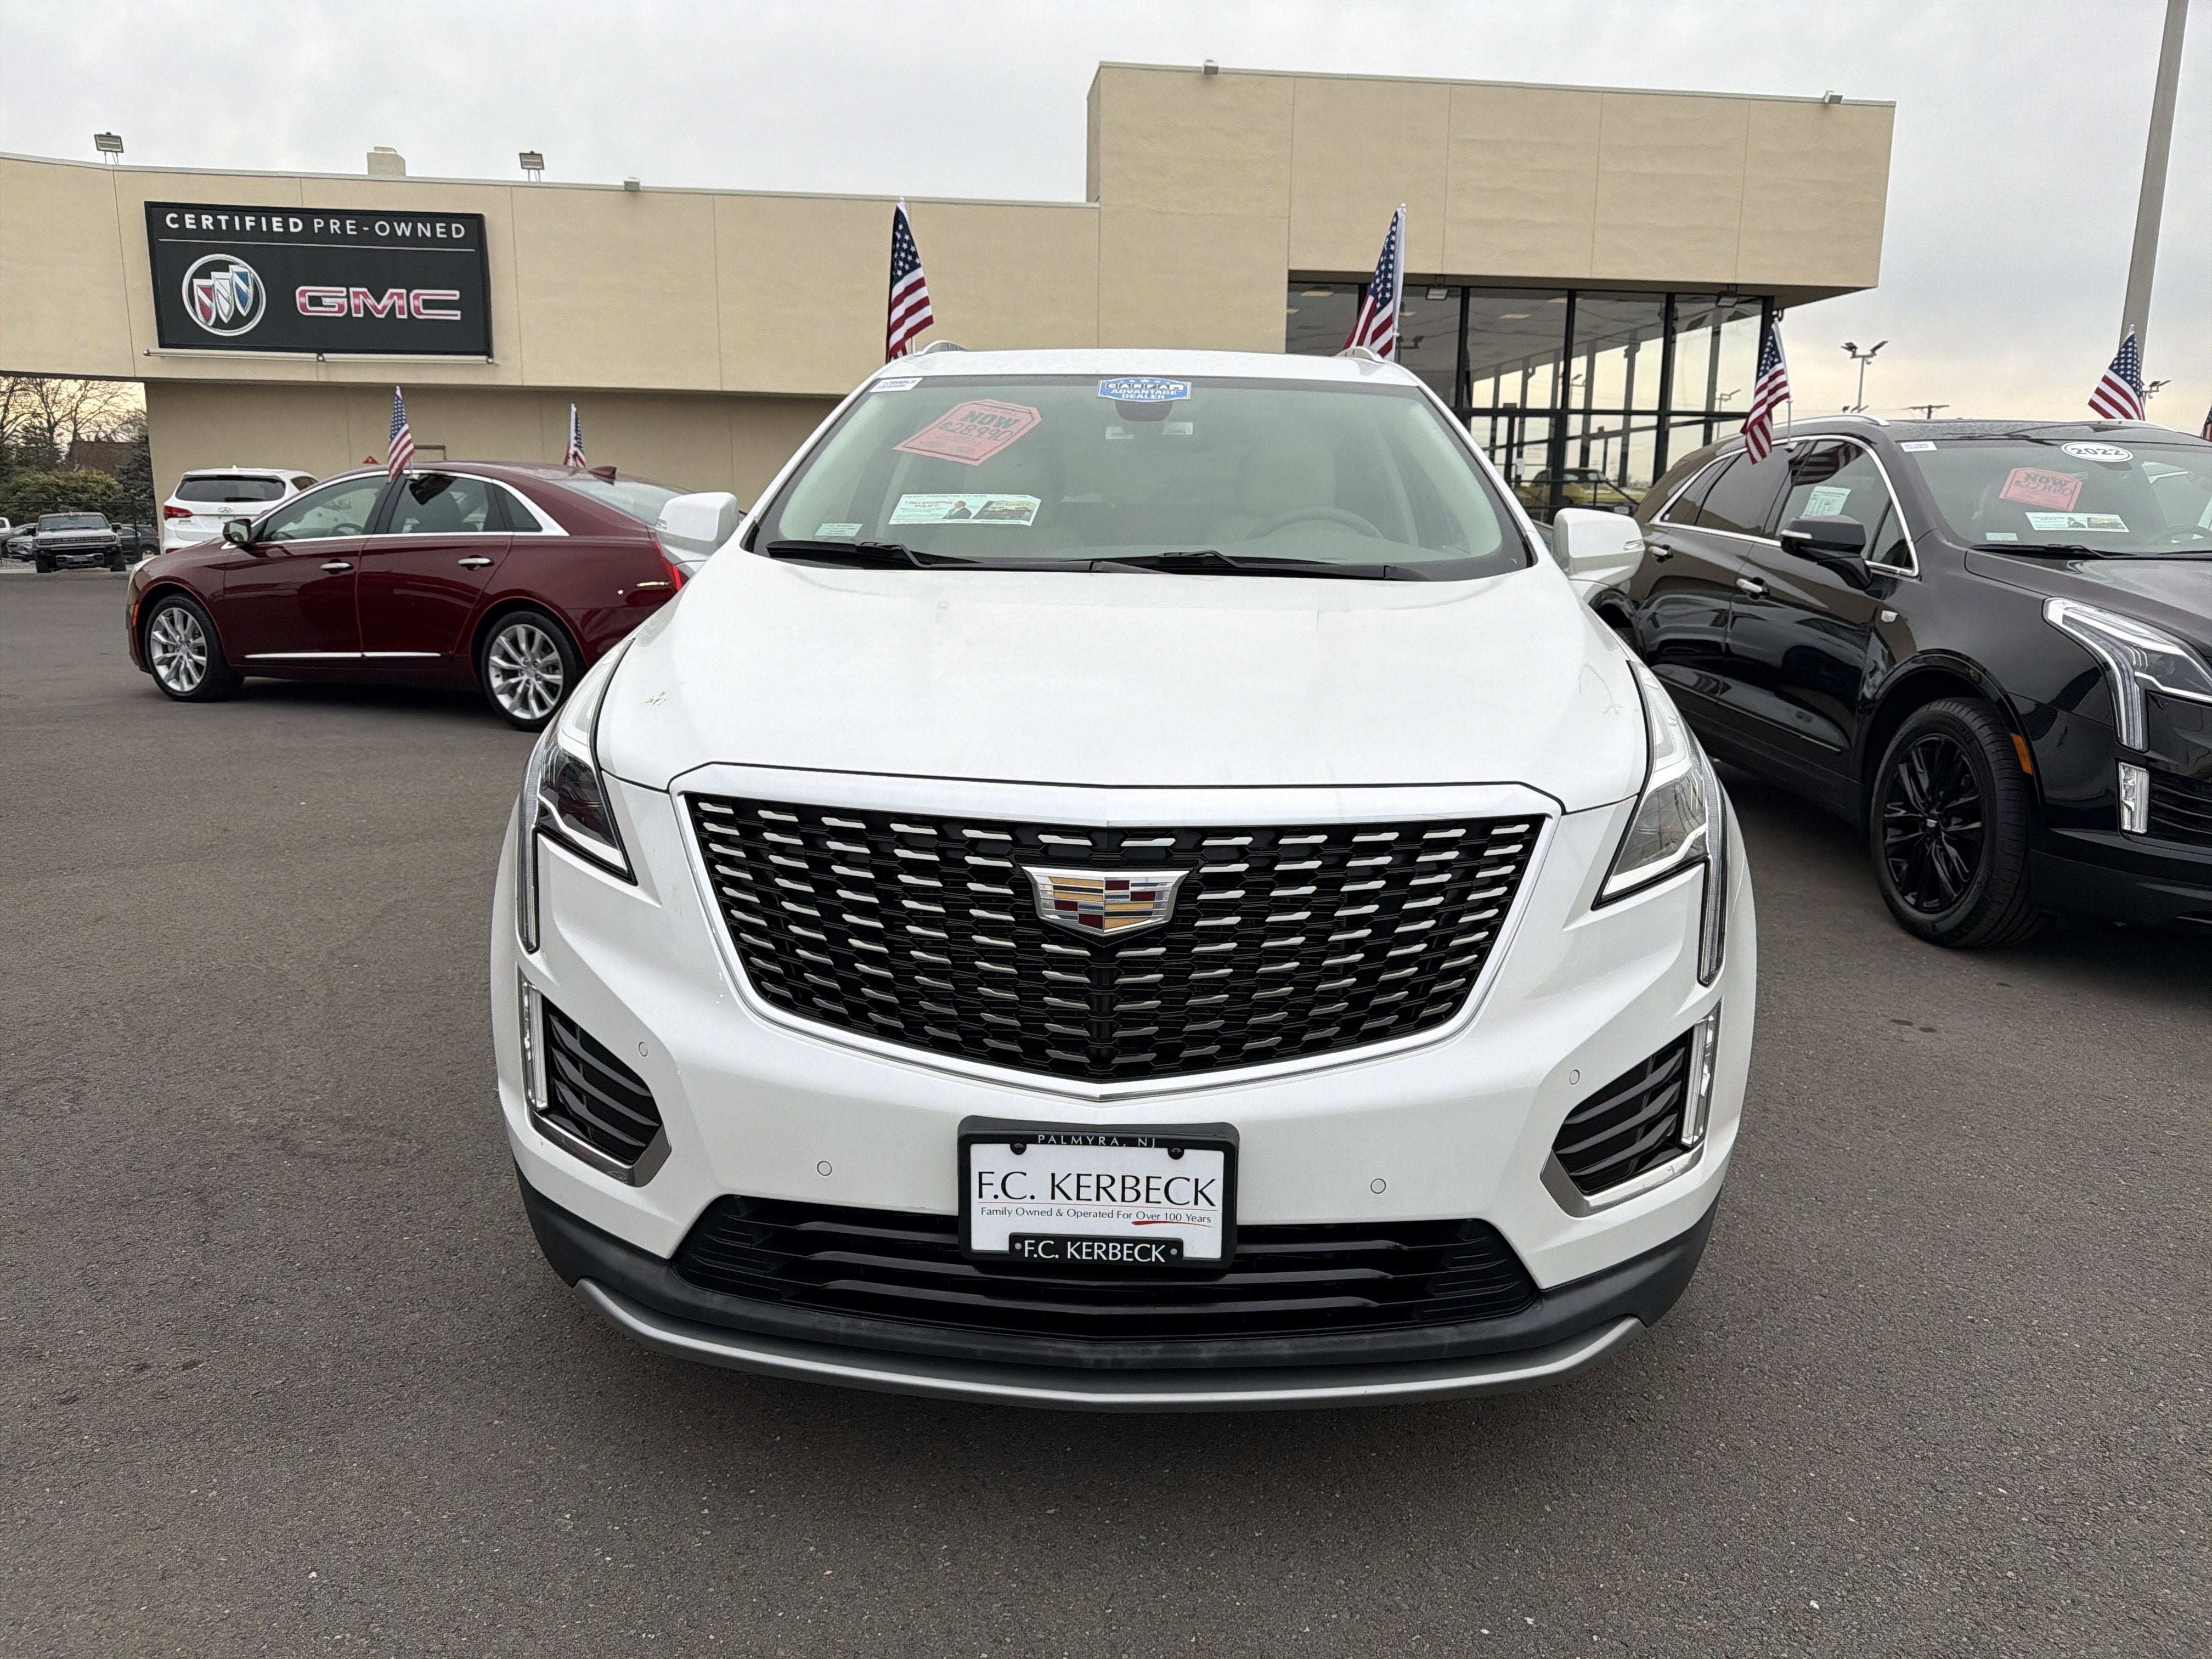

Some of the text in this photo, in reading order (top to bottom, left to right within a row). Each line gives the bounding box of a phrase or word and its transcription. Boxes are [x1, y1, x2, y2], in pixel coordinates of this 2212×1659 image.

[166, 212, 465, 238] CERTIFIED PRE-OWNED
[296, 286, 461, 320] GMC
[960, 410, 1021, 430] NOW
[2024, 473, 2068, 487] NOW
[1037, 1134, 1156, 1148] PALMYRA, NJ
[978, 1171, 1216, 1206] F.C. KERBECK
[981, 1207, 1211, 1223] Family Owned & Operated For Over 100 Years
[1024, 1240, 1166, 1262] F.C. KERBECK
